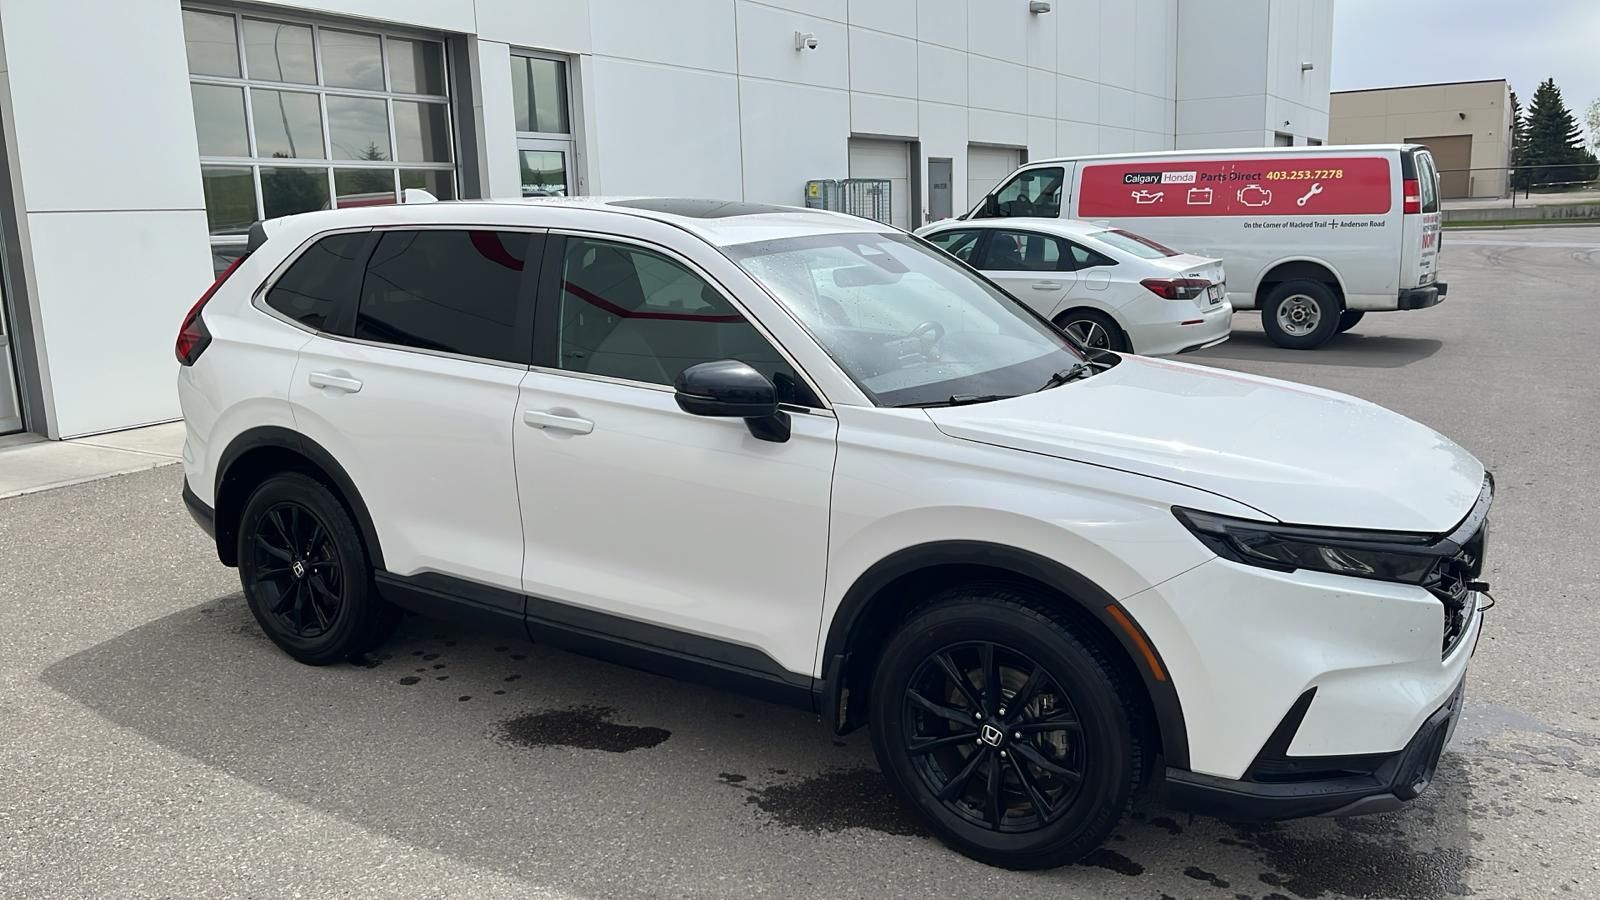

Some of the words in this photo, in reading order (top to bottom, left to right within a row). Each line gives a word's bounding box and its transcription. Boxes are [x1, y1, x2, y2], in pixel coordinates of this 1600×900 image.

[1125, 174, 1159, 184] Calgary
[1164, 174, 1194, 182] Honda
[1201, 173, 1227, 181] Parts
[1266, 170, 1343, 180] 403.253.7278
[1290, 220, 1313, 228] Macleod
[1315, 220, 1327, 228] Trail
[1340, 220, 1368, 228] Anderson
